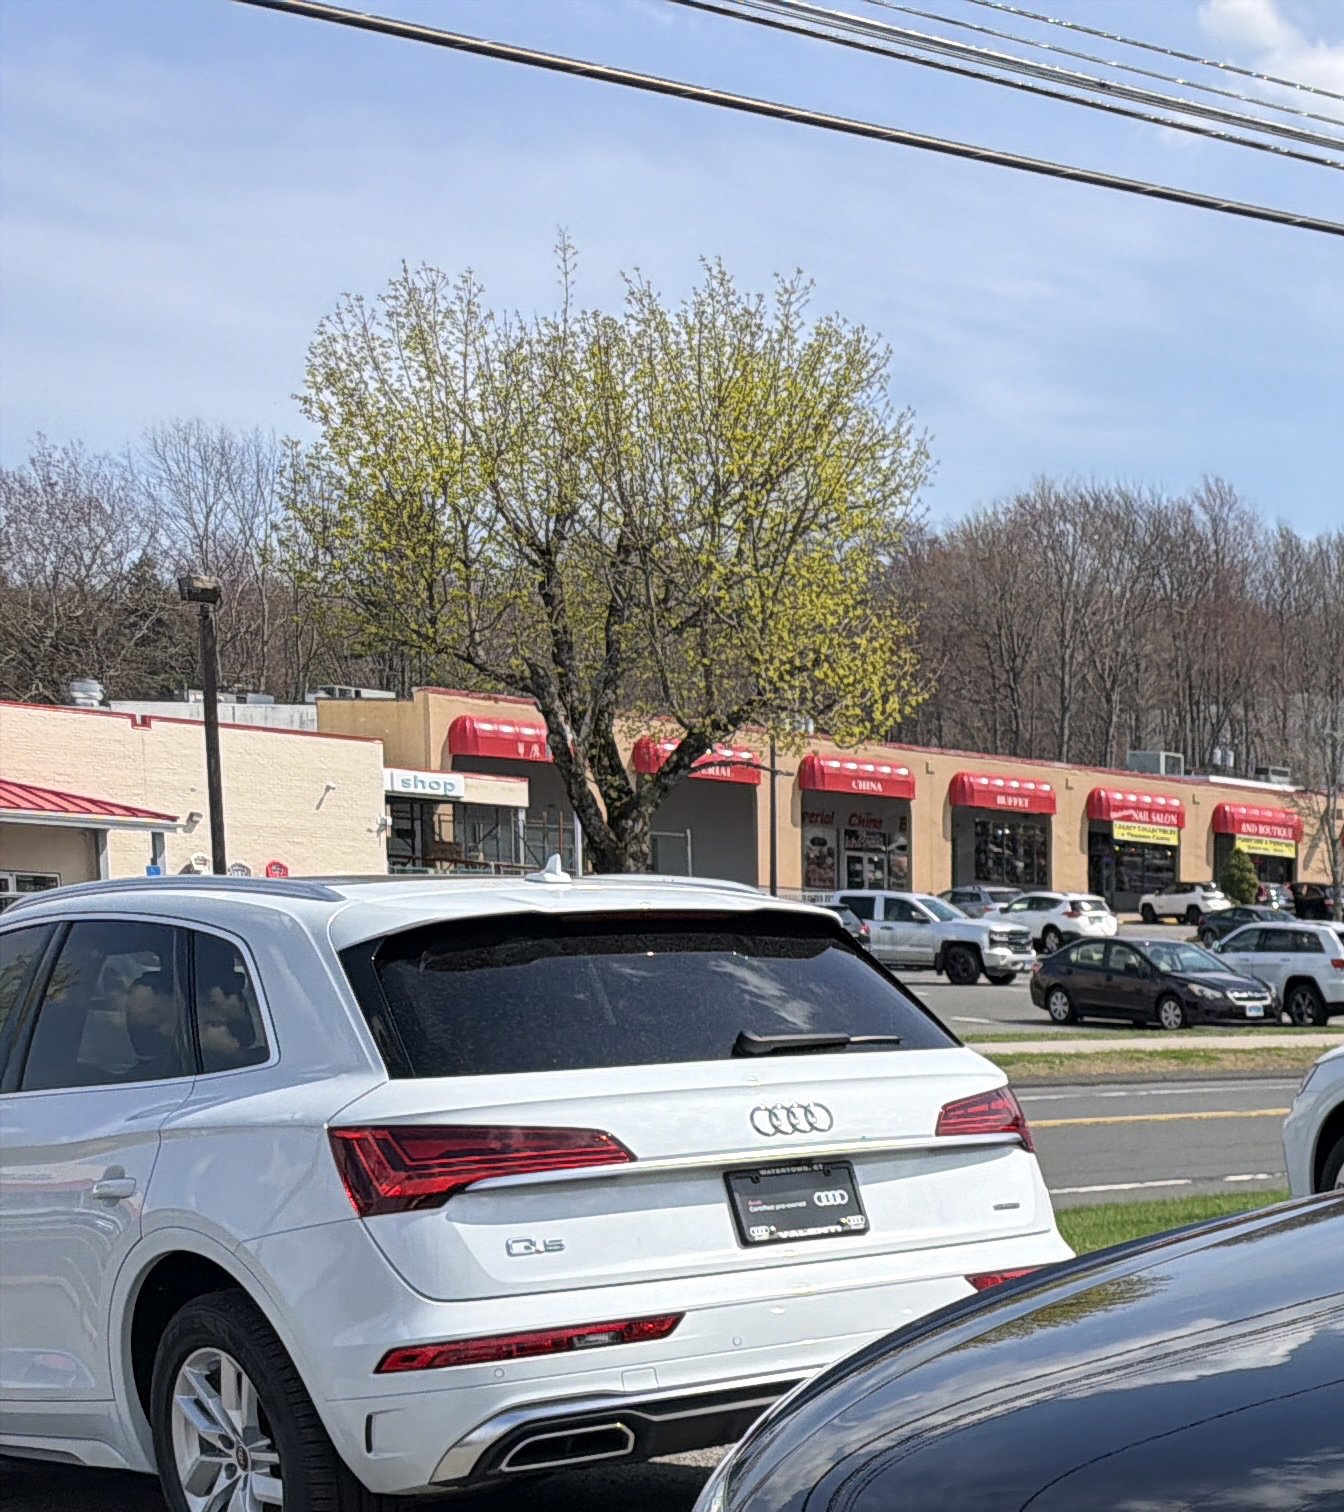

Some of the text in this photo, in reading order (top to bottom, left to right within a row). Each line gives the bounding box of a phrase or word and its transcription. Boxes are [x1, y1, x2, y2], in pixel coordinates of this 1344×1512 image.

[400, 774, 457, 797] shop
[851, 779, 883, 792] CHINA
[1151, 812, 1178, 825] SALON
